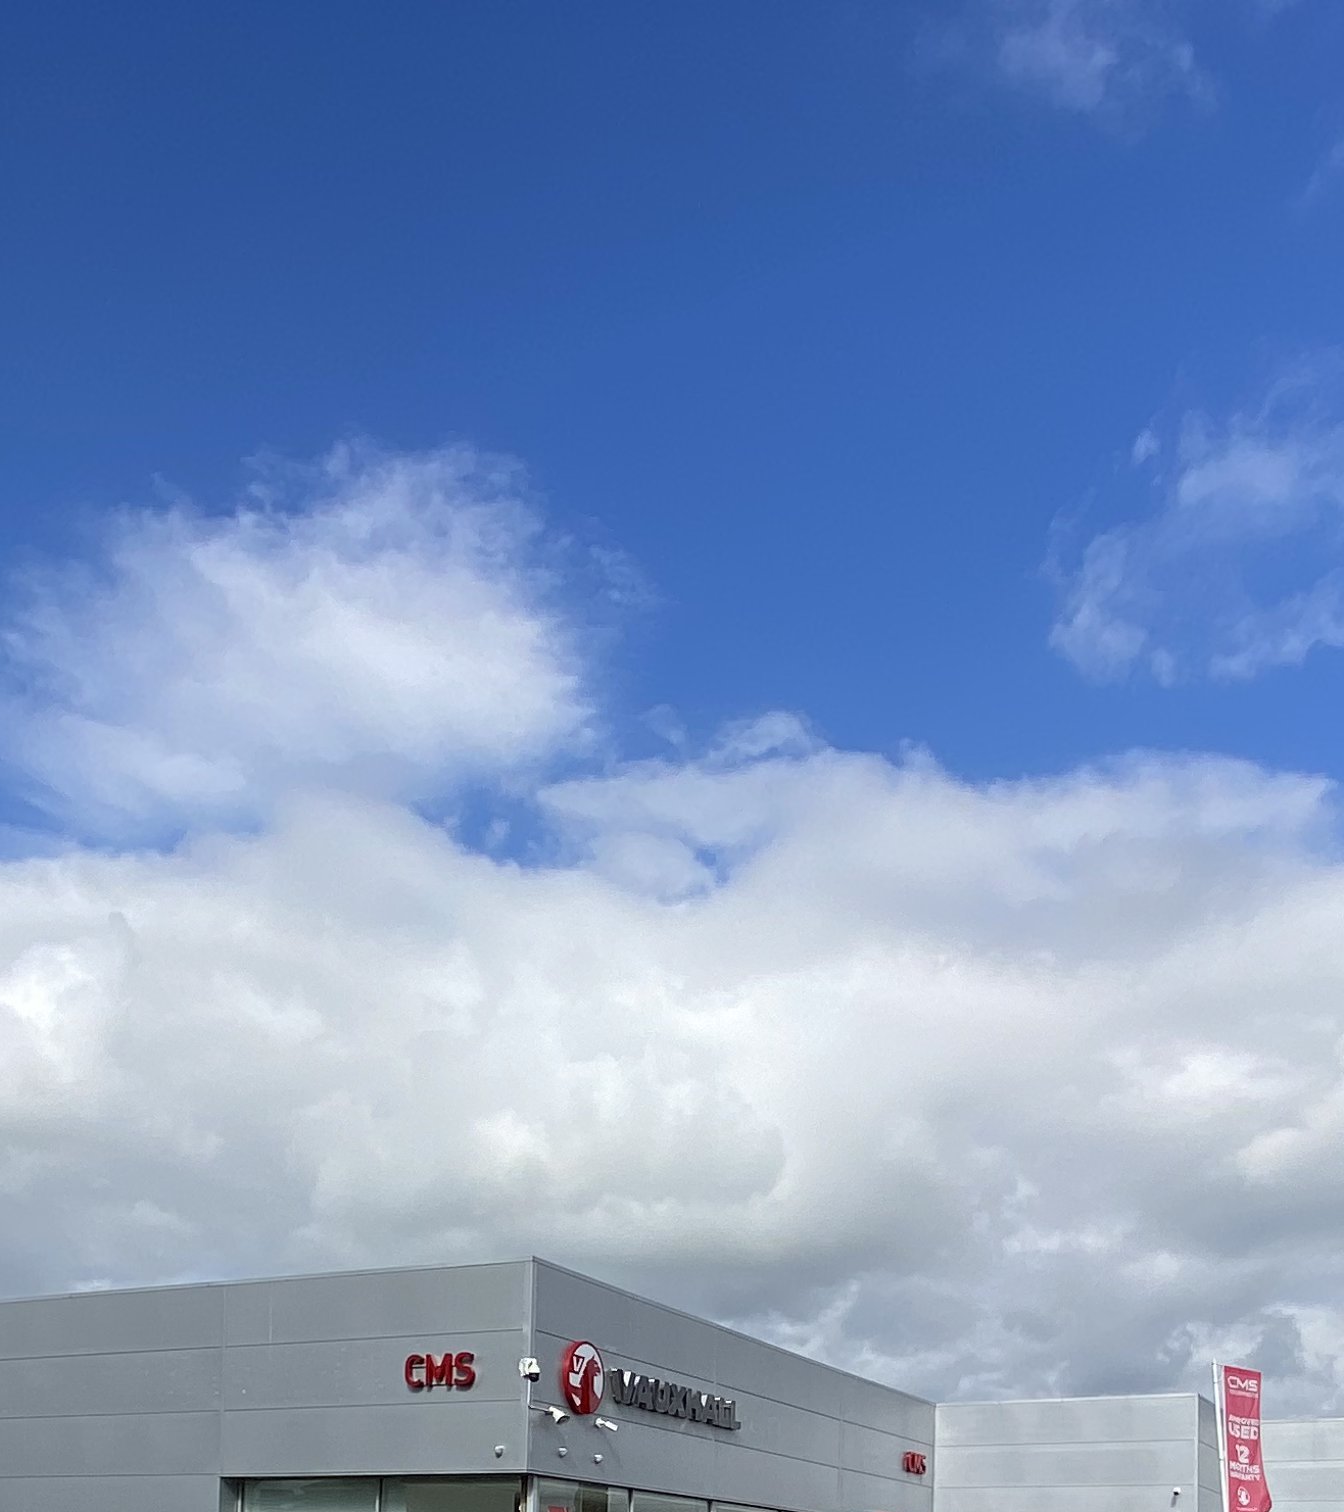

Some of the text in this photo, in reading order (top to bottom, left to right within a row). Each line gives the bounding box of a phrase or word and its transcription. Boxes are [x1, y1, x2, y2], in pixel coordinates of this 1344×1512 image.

[405, 1352, 476, 1388] CMS
[1227, 1375, 1258, 1391] CMS
[609, 1367, 741, 1430] VAUXHALL
[1228, 1421, 1259, 1440] USED
